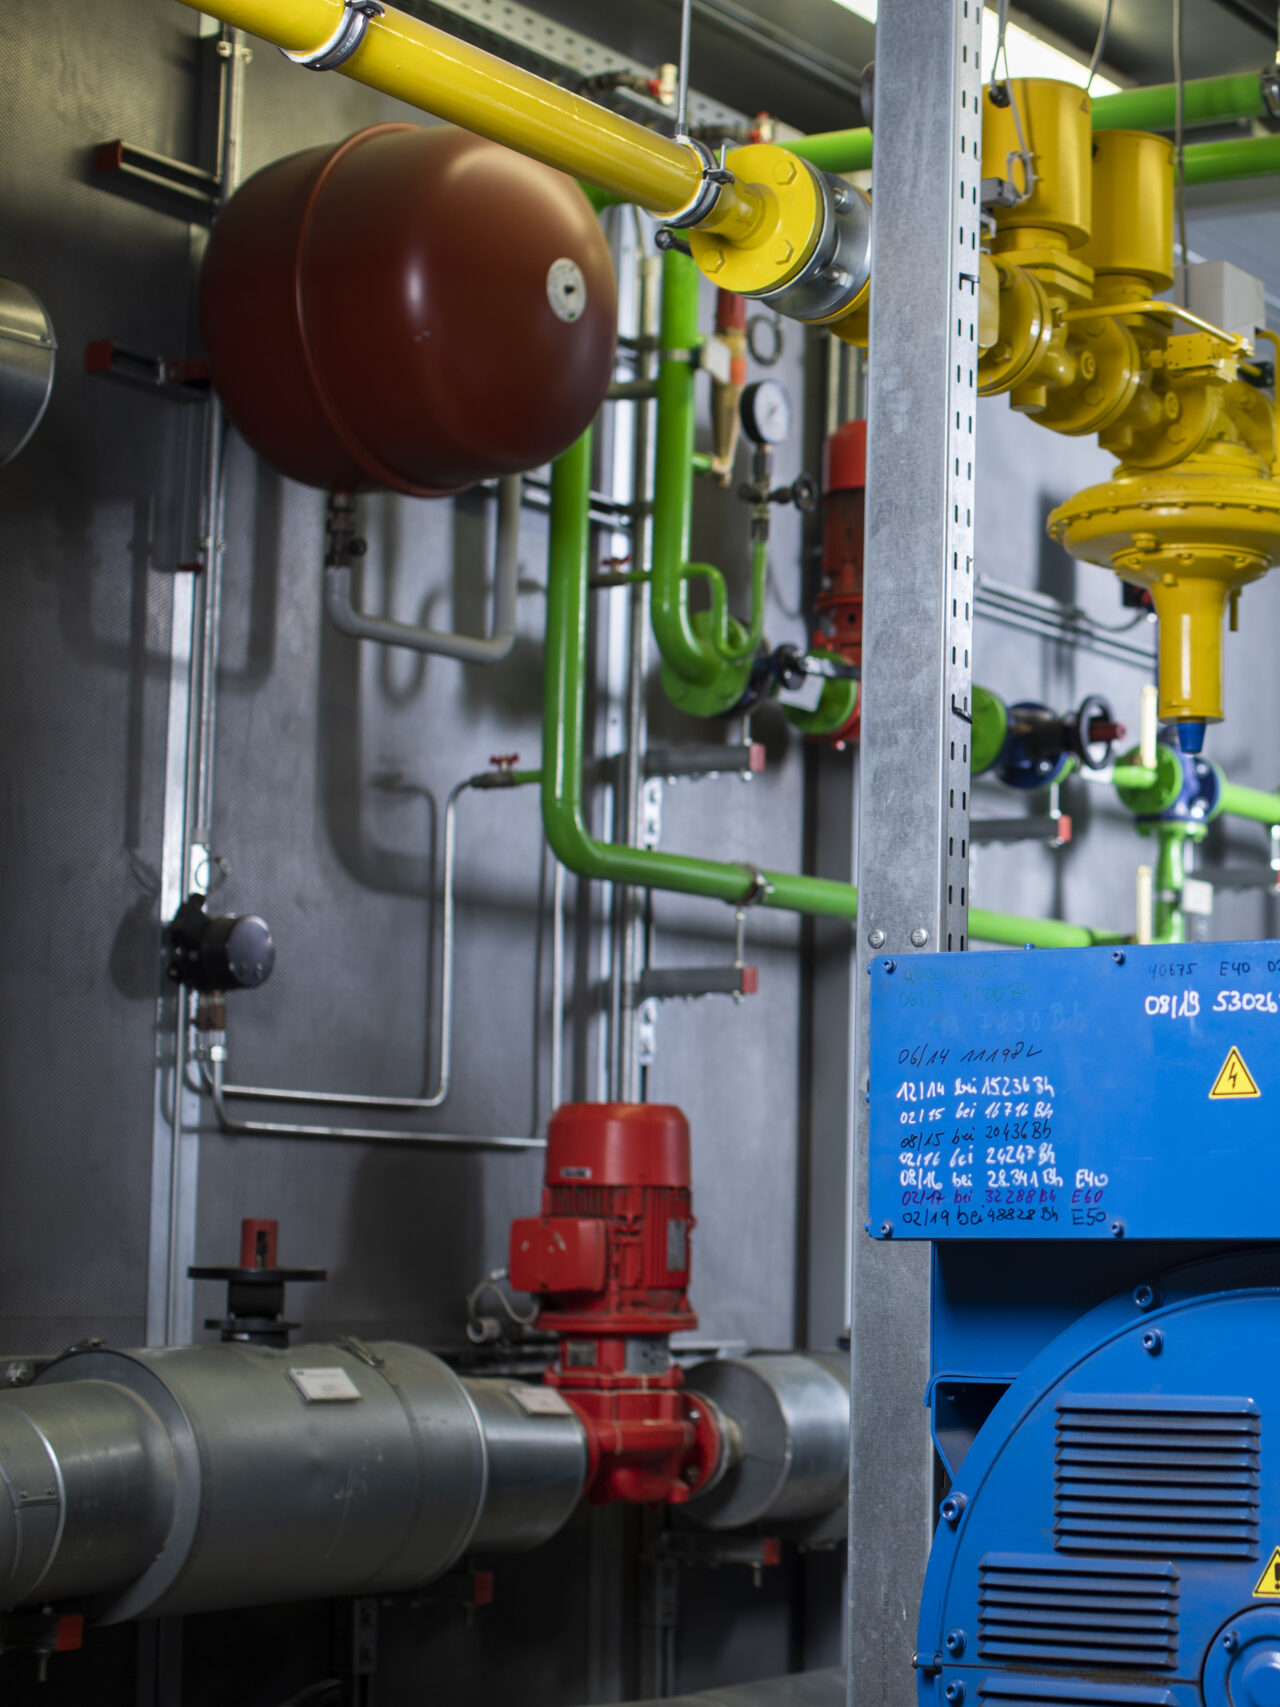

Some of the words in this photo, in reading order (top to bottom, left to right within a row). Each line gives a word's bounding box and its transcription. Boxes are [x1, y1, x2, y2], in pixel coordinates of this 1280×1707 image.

[1219, 961, 1251, 976] E40
[1144, 990, 1200, 1019] 08/19
[899, 1043, 950, 1067] 06/14
[896, 1081, 945, 1102] 12/14
[954, 1077, 977, 1096] bei
[900, 1107, 946, 1124] 02/15
[955, 1102, 977, 1119] bei
[900, 1131, 945, 1152] 08/15
[952, 1127, 975, 1144] bei
[899, 1151, 941, 1167] 02/16
[949, 1145, 974, 1168] bei
[900, 1168, 943, 1190] 08/16
[952, 1172, 973, 1187] bei
[1075, 1169, 1109, 1188] E40
[901, 1190, 945, 1206] 02/17
[954, 1189, 973, 1205] bei
[1072, 1189, 1105, 1204] E60
[902, 1208, 950, 1226] 02/19
[957, 1205, 985, 1225] bei
[1072, 1207, 1107, 1225] E50
